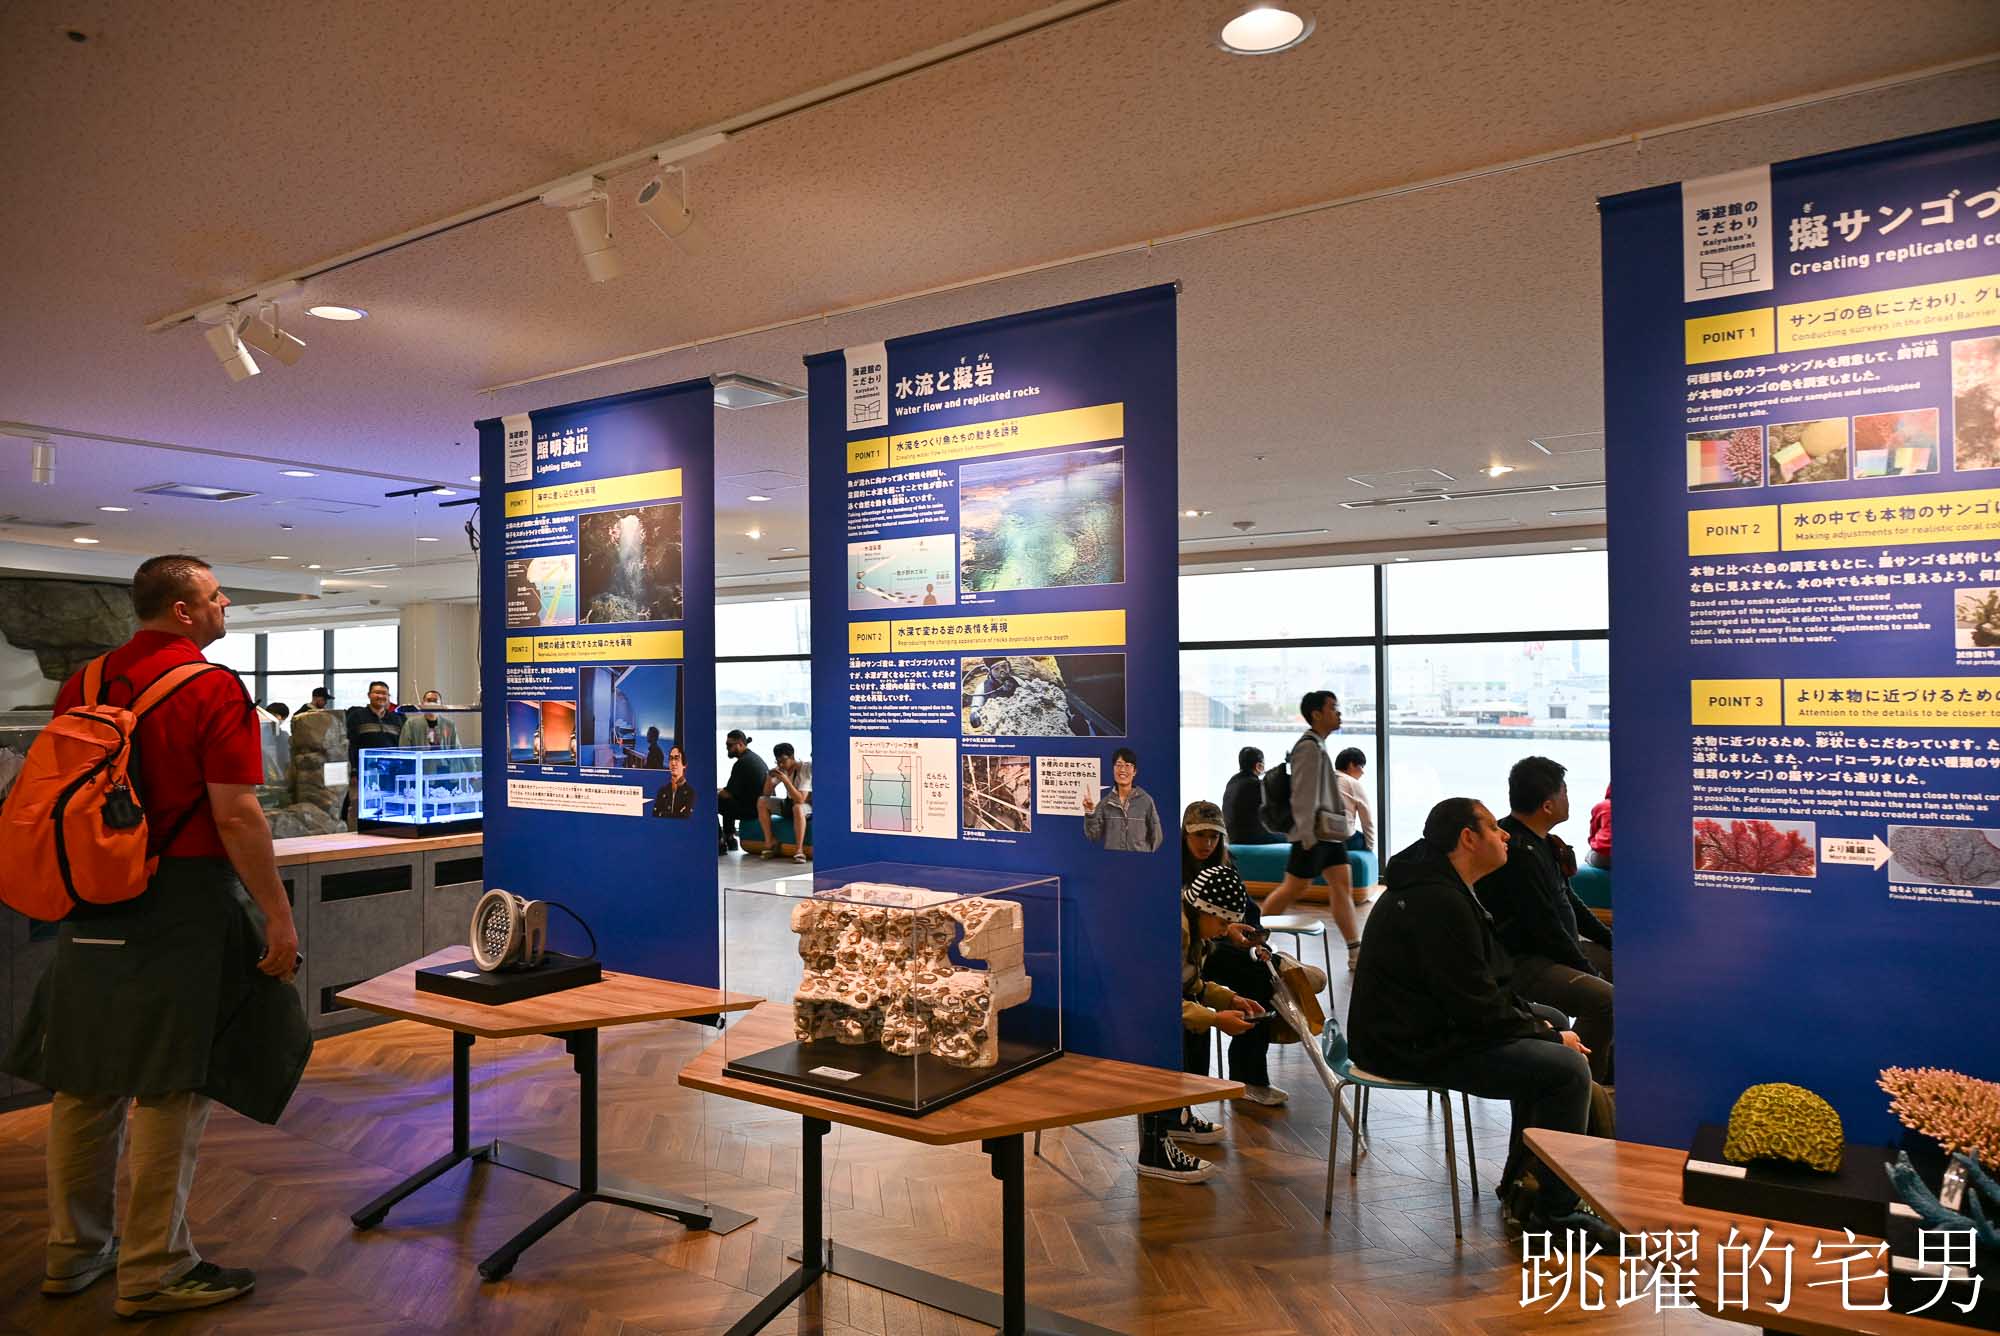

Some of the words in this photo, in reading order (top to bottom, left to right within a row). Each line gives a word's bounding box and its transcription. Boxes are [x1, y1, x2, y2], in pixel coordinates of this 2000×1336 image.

[1696, 201, 1758, 222] 海遊館の
[1697, 216, 1757, 236] こだわり
[1703, 232, 1752, 248] Kaiyukan's
[1700, 242, 1755, 256] commitment
[1790, 254, 1870, 276] Creating
[1875, 233, 1978, 264] replicated
[1703, 329, 1744, 344] POINT
[1750, 327, 1756, 338] 1
[852, 374, 882, 387] こだわり
[895, 362, 995, 399] 水流と擬岩
[1686, 370, 1881, 402] が本物のサンゴの色を調査しました。
[895, 405, 922, 417] Water
[923, 403, 942, 413] flow
[944, 399, 961, 409] and
[963, 391, 1011, 407] replicated
[1013, 386, 1040, 397] rocks
[1686, 404, 1701, 413] Our
[1703, 400, 1737, 413] keepers
[1738, 395, 1779, 410] prepared
[1779, 393, 1804, 404] color
[1803, 389, 1843, 403] samples
[1842, 387, 1862, 397] and
[1861, 381, 1922, 397] investigated
[1686, 413, 1708, 422] coral
[1709, 411, 1736, 420] colors
[1749, 408, 1768, 417] site.
[537, 434, 588, 460] 照明演出
[855, 451, 875, 461] POINT
[537, 463, 560, 474] Lighting
[561, 460, 582, 470] Effects
[1706, 525, 1748, 536] POINT
[1753, 524, 1761, 535] 2
[1690, 598, 1715, 607] Based
[1730, 597, 1745, 606] the
[1746, 596, 1774, 605] onsite
[1776, 595, 1799, 604] color
[1802, 596, 1836, 605] survey,
[1853, 592, 1890, 602] created
[1690, 606, 1736, 618] prototypes
[1737, 606, 1747, 615] of
[1748, 606, 1763, 614] the
[1765, 604, 1811, 616] replicated
[1813, 603, 1845, 613] corals.
[1847, 602, 1893, 614] However,
[1894, 601, 1922, 610] when
[1690, 616, 1738, 627] submerged
[1740, 615, 1749, 624] in
[1750, 615, 1765, 624] the
[1767, 614, 1790, 625] tank,
[1792, 614, 1799, 623] it
[1801, 613, 1828, 622] didn't
[1829, 613, 1854, 622] show
[1856, 612, 1872, 621] the
[1873, 611, 1918, 622] expected
[897, 622, 1008, 637] 水深で変わる岩の表情を再現
[1690, 626, 1715, 635] color.
[1717, 626, 1730, 634] We
[1732, 625, 1756, 634] made
[1758, 626, 1783, 635] many
[1784, 624, 1802, 633] fine
[1804, 624, 1828, 632] color
[1830, 622, 1889, 634] adjustments
[1891, 622, 1902, 631] to
[1903, 621, 1931, 630] make
[878, 633, 882, 641] 2
[1690, 636, 1712, 644] them
[1714, 635, 1732, 644] look
[1734, 635, 1753, 644] real
[1778, 635, 1787, 643] in
[1789, 634, 1804, 643] the
[1806, 634, 1836, 643] water.
[1709, 697, 1751, 707] POINT
[1756, 697, 1763, 707] 3
[1798, 708, 1845, 717] Attention
[1848, 708, 1858, 717] to
[1862, 709, 1878, 717] the
[1882, 709, 1918, 717] details
[1921, 709, 1932, 717] to
[1936, 709, 1947, 717] be
[1952, 709, 1986, 717] closer
[1990, 709, 2000, 717] to
[1692, 783, 1705, 792] We
[1707, 785, 1722, 794] pay
[1723, 784, 1746, 793] close
[1748, 785, 1787, 794] attention
[1788, 786, 1798, 794] to
[1799, 786, 1814, 795] the
[1816, 787, 1842, 798] shape
[1844, 788, 1854, 796] to
[1855, 788, 1881, 797] make
[1883, 789, 1907, 798] them
[1922, 790, 1947, 799] close
[1949, 791, 1960, 800] to
[1961, 791, 1982, 800] real
